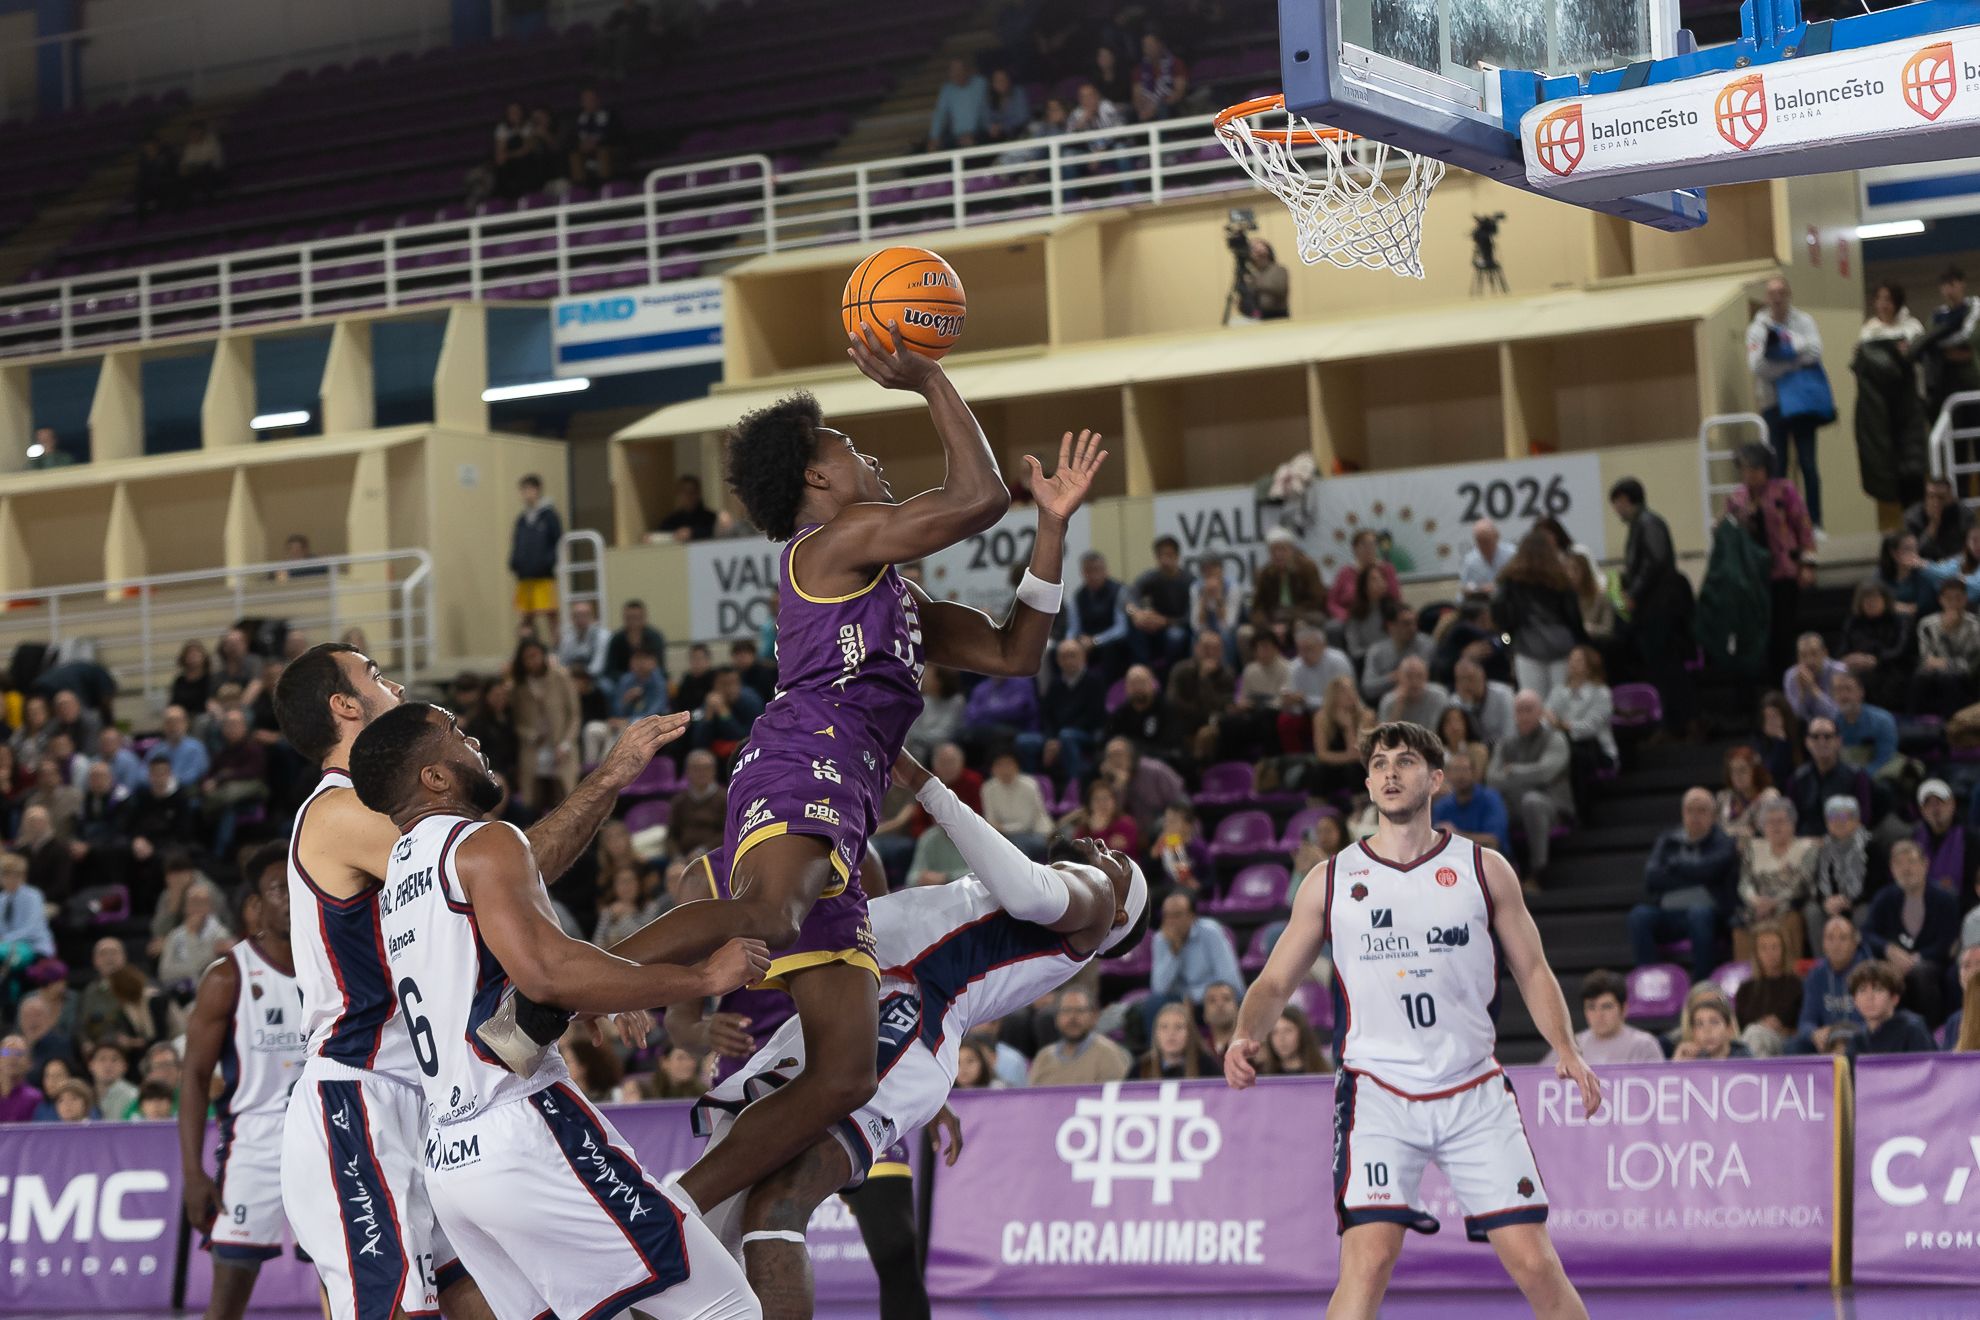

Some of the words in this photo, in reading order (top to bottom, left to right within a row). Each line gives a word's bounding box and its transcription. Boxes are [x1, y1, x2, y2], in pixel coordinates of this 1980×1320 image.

[1776, 108, 1822, 123] ESPAÑA
[1593, 138, 1638, 152] ESPAÑA
[558, 295, 636, 328] FMD
[1457, 473, 1572, 522] 2026
[1360, 931, 1410, 953] Jaén
[1400, 992, 1437, 1030] 10
[397, 976, 439, 1078] 6
[1537, 1073, 1825, 1128] RESIDENCIAL
[1363, 1161, 1389, 1188] 10
[1606, 1141, 1751, 1192] LOYRA
[1366, 1191, 1392, 1201] vive
[233, 1203, 247, 1225] 9
[1622, 1208, 1650, 1231] DE
[1655, 1207, 1678, 1230] LA
[1681, 1205, 1825, 1229] ENCOMIENDA
[1001, 1220, 1266, 1265] CARRAMIMBRE
[1904, 1230, 1980, 1250] PROM
